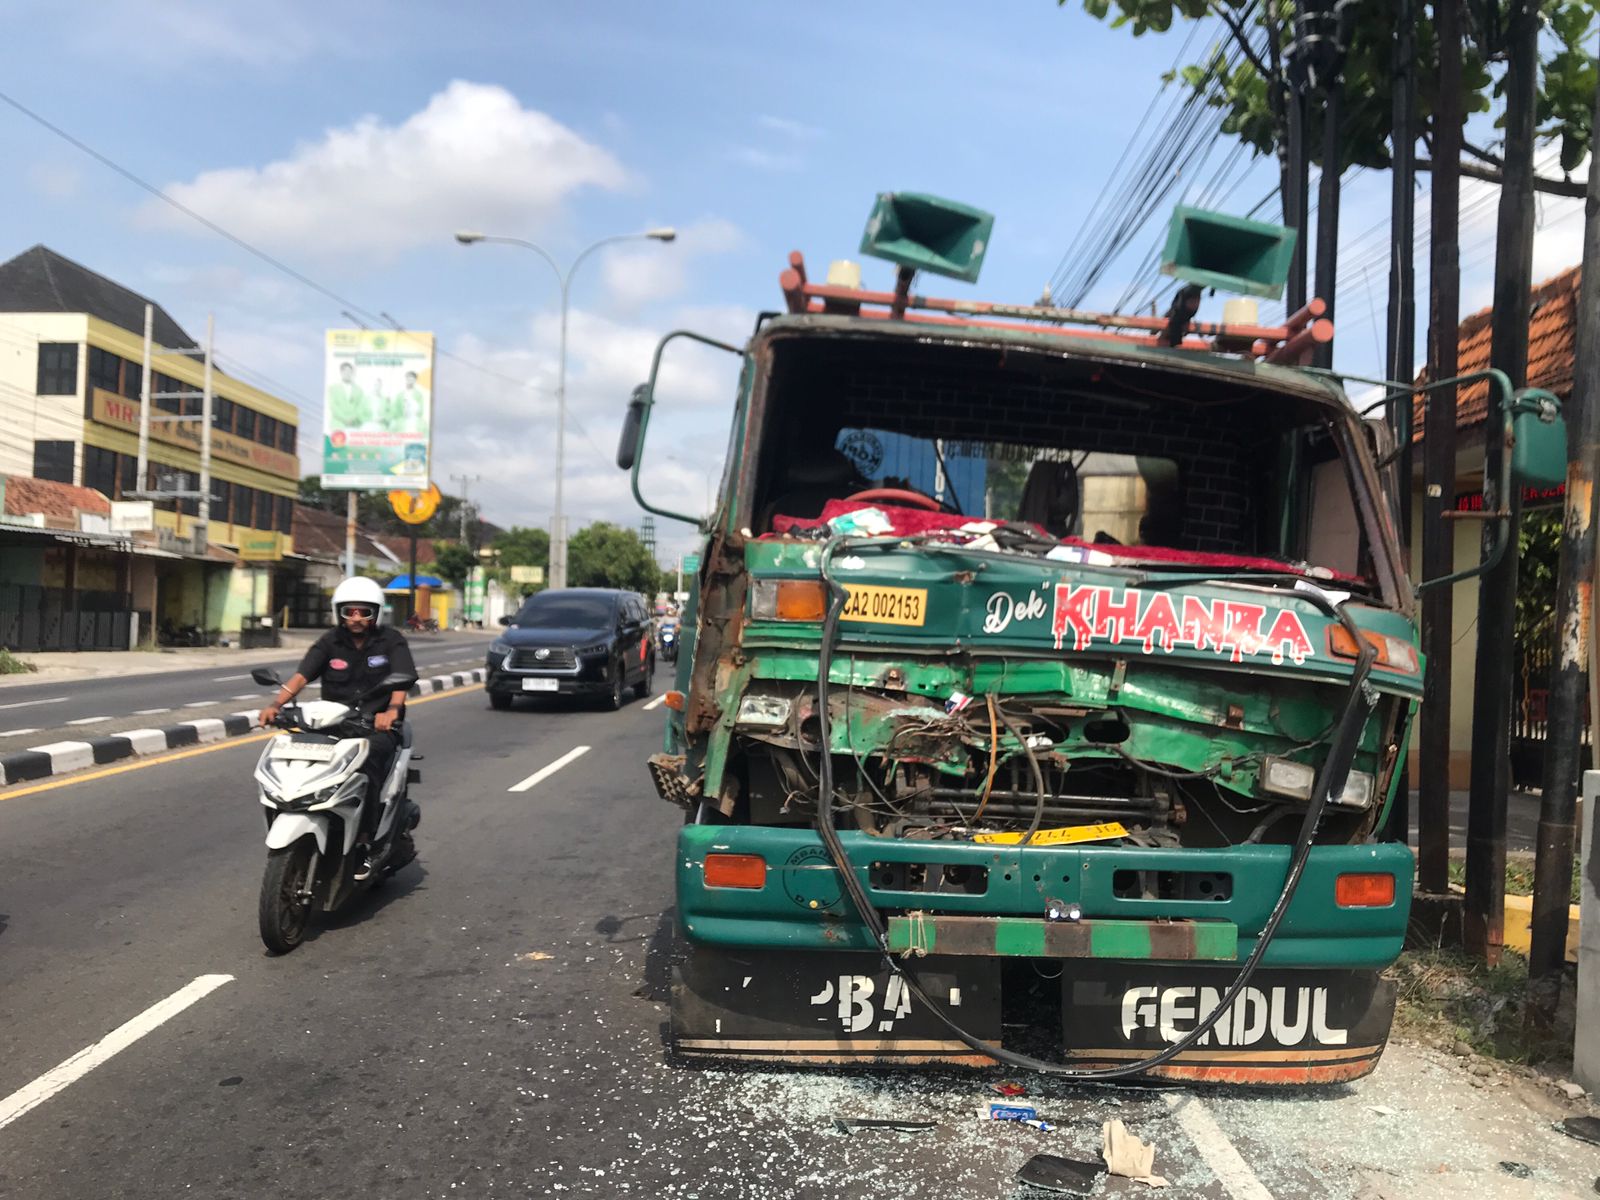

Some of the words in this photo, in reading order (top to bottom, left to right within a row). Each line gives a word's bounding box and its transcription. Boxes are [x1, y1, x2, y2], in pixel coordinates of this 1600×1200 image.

[872, 592, 920, 620] 002153
[1051, 583, 1316, 665] KHANZA
[1121, 986, 1348, 1046] GENDUL
